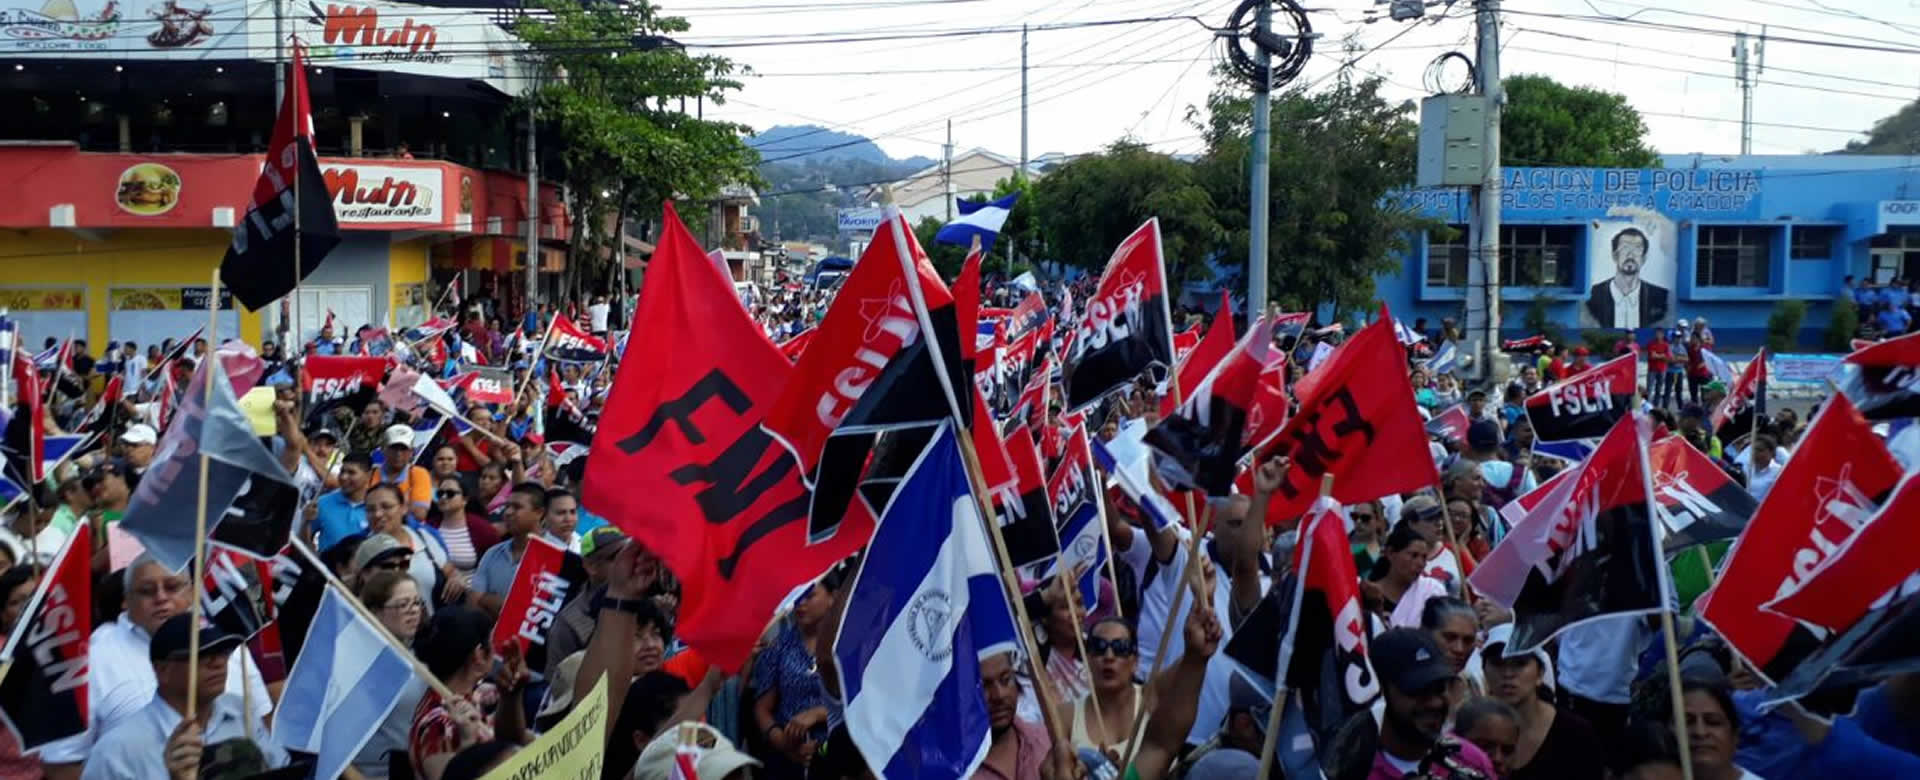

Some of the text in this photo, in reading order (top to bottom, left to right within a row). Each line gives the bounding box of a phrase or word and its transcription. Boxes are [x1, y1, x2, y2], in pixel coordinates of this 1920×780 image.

[1605, 170, 1640, 192] DE
[1652, 170, 1759, 192] POLICIA
[341, 204, 432, 218] restaurantes
[1501, 192, 1555, 209] RLOS
[310, 374, 363, 404] FSLN
[1549, 380, 1614, 417] FSLN
[1056, 460, 1086, 514] SLN
[518, 571, 571, 645] FSLN
